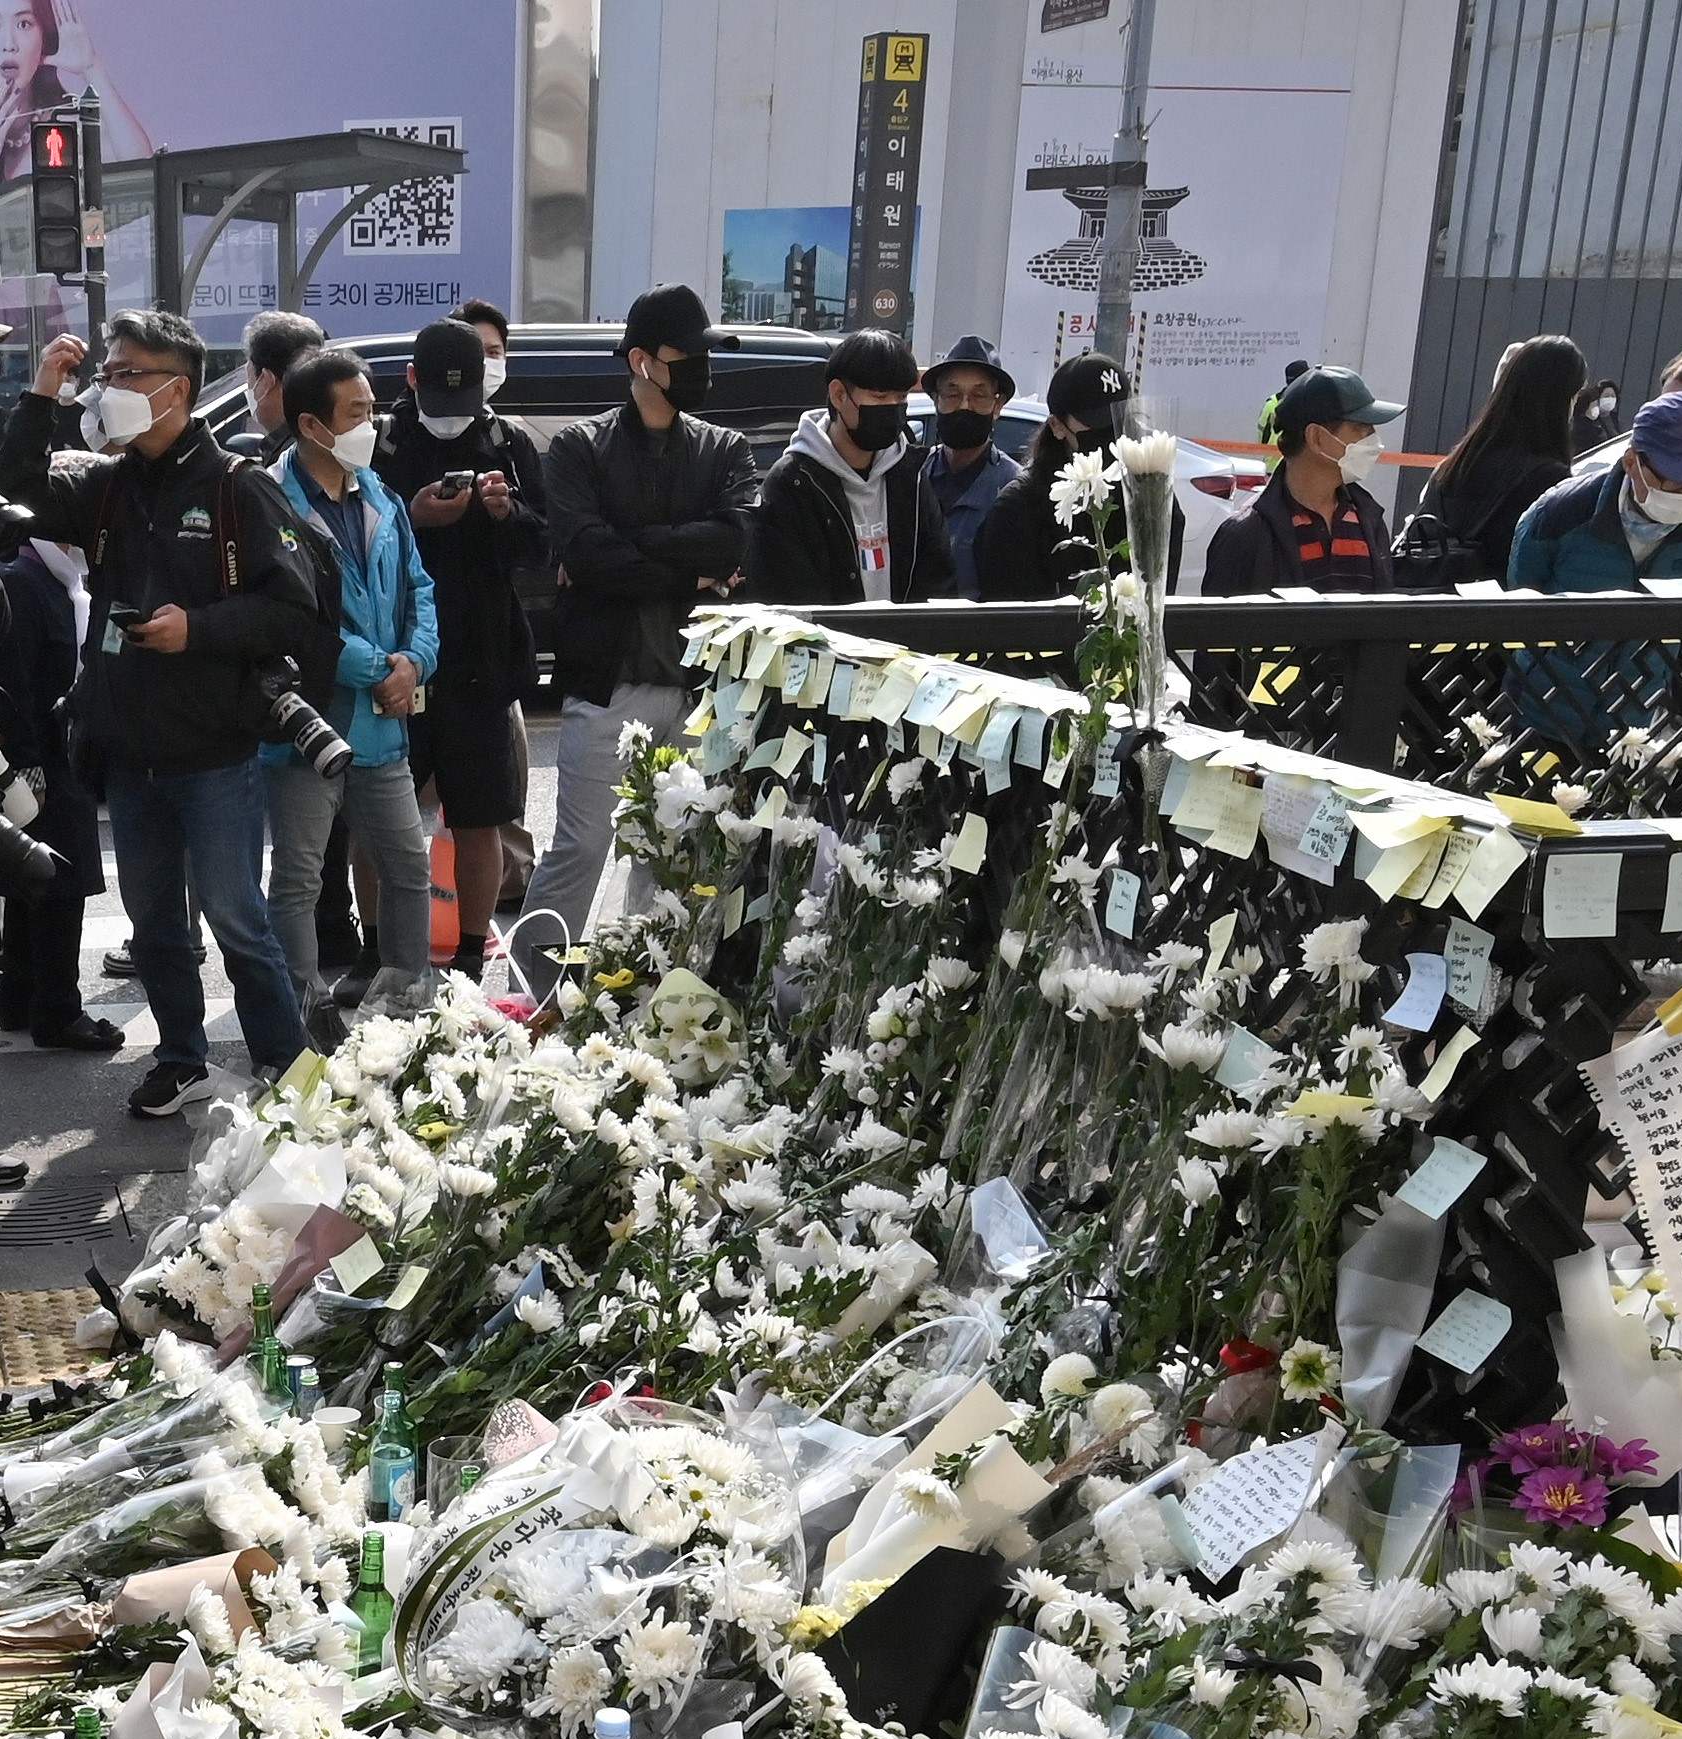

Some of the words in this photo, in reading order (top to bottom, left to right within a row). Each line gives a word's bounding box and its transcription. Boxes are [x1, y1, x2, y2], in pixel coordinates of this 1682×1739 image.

[894, 89, 909, 113] 4
[882, 136, 906, 226] 이태원
[238, 283, 276, 306] 뜨면
[328, 283, 368, 305] 것이
[373, 282, 460, 306] 공개된다!
[876, 299, 895, 309] 630
[1154, 313, 1196, 327] 효창공원
[227, 541, 237, 585] Canon
[489, 1506, 562, 1562] 꽃다운
